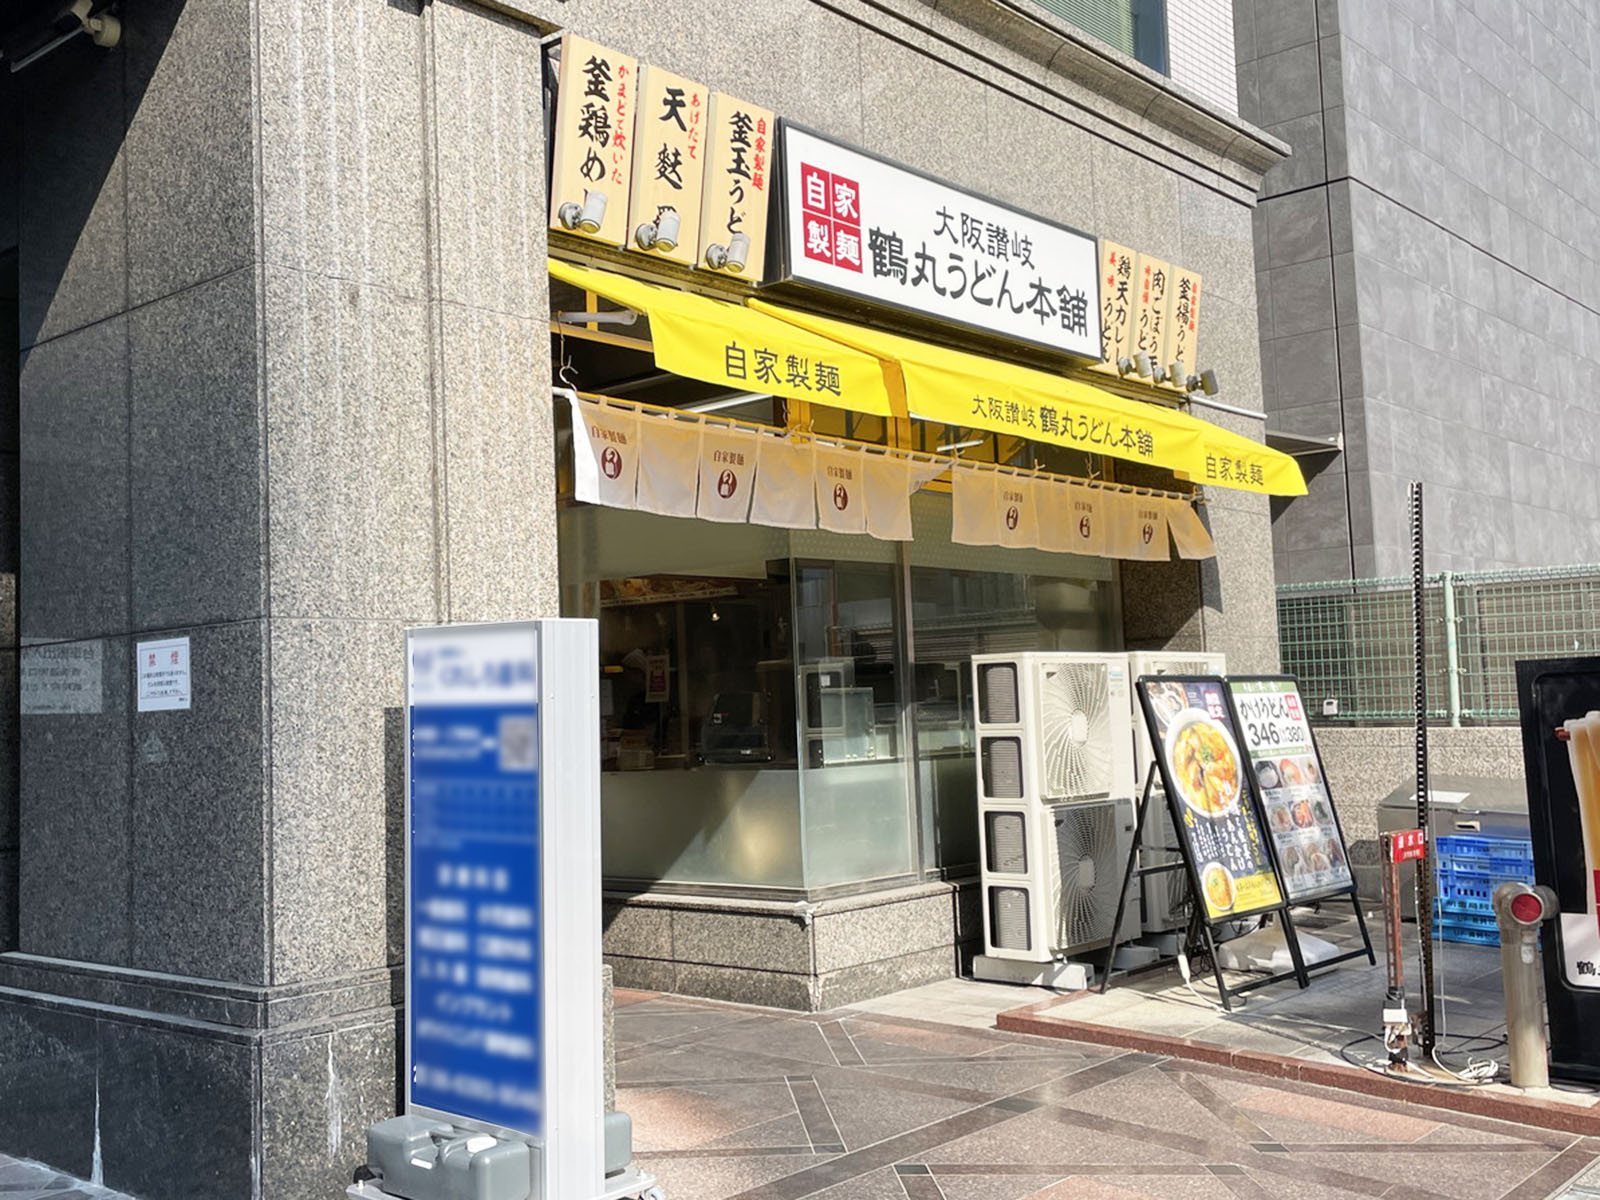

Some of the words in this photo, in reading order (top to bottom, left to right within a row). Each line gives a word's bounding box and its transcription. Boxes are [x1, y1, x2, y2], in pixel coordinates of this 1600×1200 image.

[578, 55, 613, 207] 釜鶏め
[751, 117, 767, 191] 自家製麺
[726, 110, 754, 234] 釜玉うど
[867, 226, 1089, 338] 鶴丸うどん本舗
[1138, 308, 1149, 351] うど
[1175, 277, 1191, 362] 釜揚うど
[725, 341, 842, 396] 自家製麺
[591, 425, 628, 446] 自家製麺
[713, 449, 745, 466] 自家製麺
[1205, 452, 1265, 487] 自家製麺
[1248, 722, 1281, 747] 346
